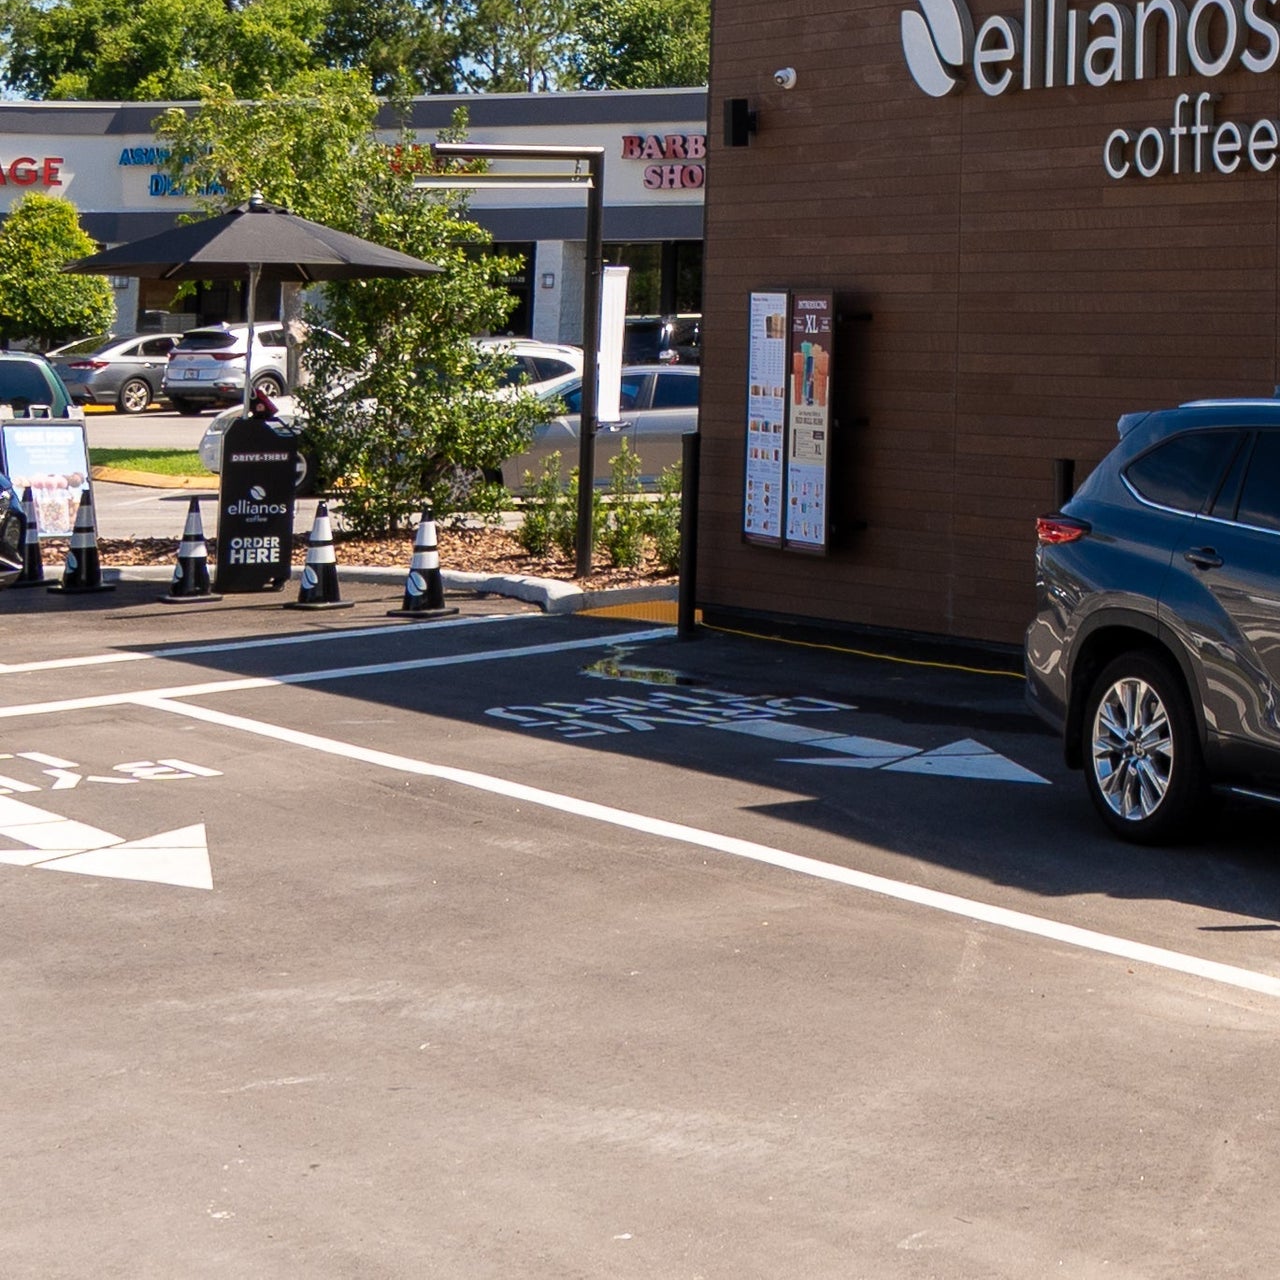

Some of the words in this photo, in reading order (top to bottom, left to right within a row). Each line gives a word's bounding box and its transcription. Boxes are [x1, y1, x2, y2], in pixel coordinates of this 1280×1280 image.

[0, 157, 64, 187] GE
[805, 314, 818, 333] XL
[232, 453, 288, 461] DRIVE-THRU
[227, 500, 287, 515] ellianos
[230, 536, 280, 549] ORDER
[229, 548, 280, 564] HERE
